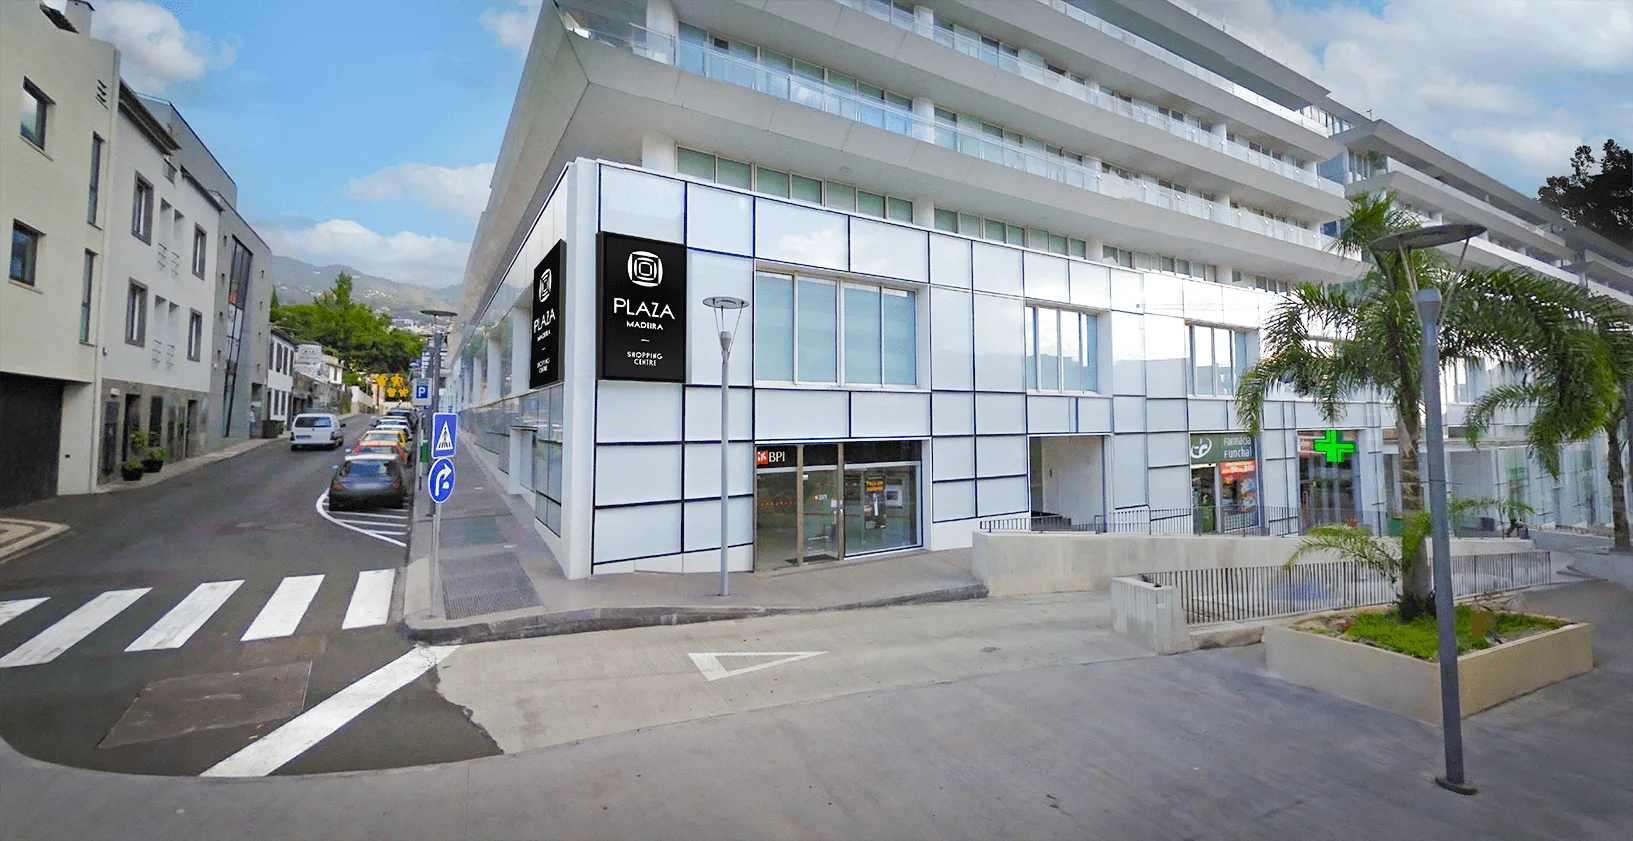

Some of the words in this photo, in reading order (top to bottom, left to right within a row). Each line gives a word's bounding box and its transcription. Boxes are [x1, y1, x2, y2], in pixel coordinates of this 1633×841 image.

[613, 297, 676, 320] PLAZA
[533, 308, 556, 333] PLAZA
[626, 320, 664, 330] MADEIRA
[626, 351, 663, 360] SHOPPING
[633, 358, 657, 366] CENTRE
[418, 386, 427, 398] P
[768, 451, 786, 463] BPI
